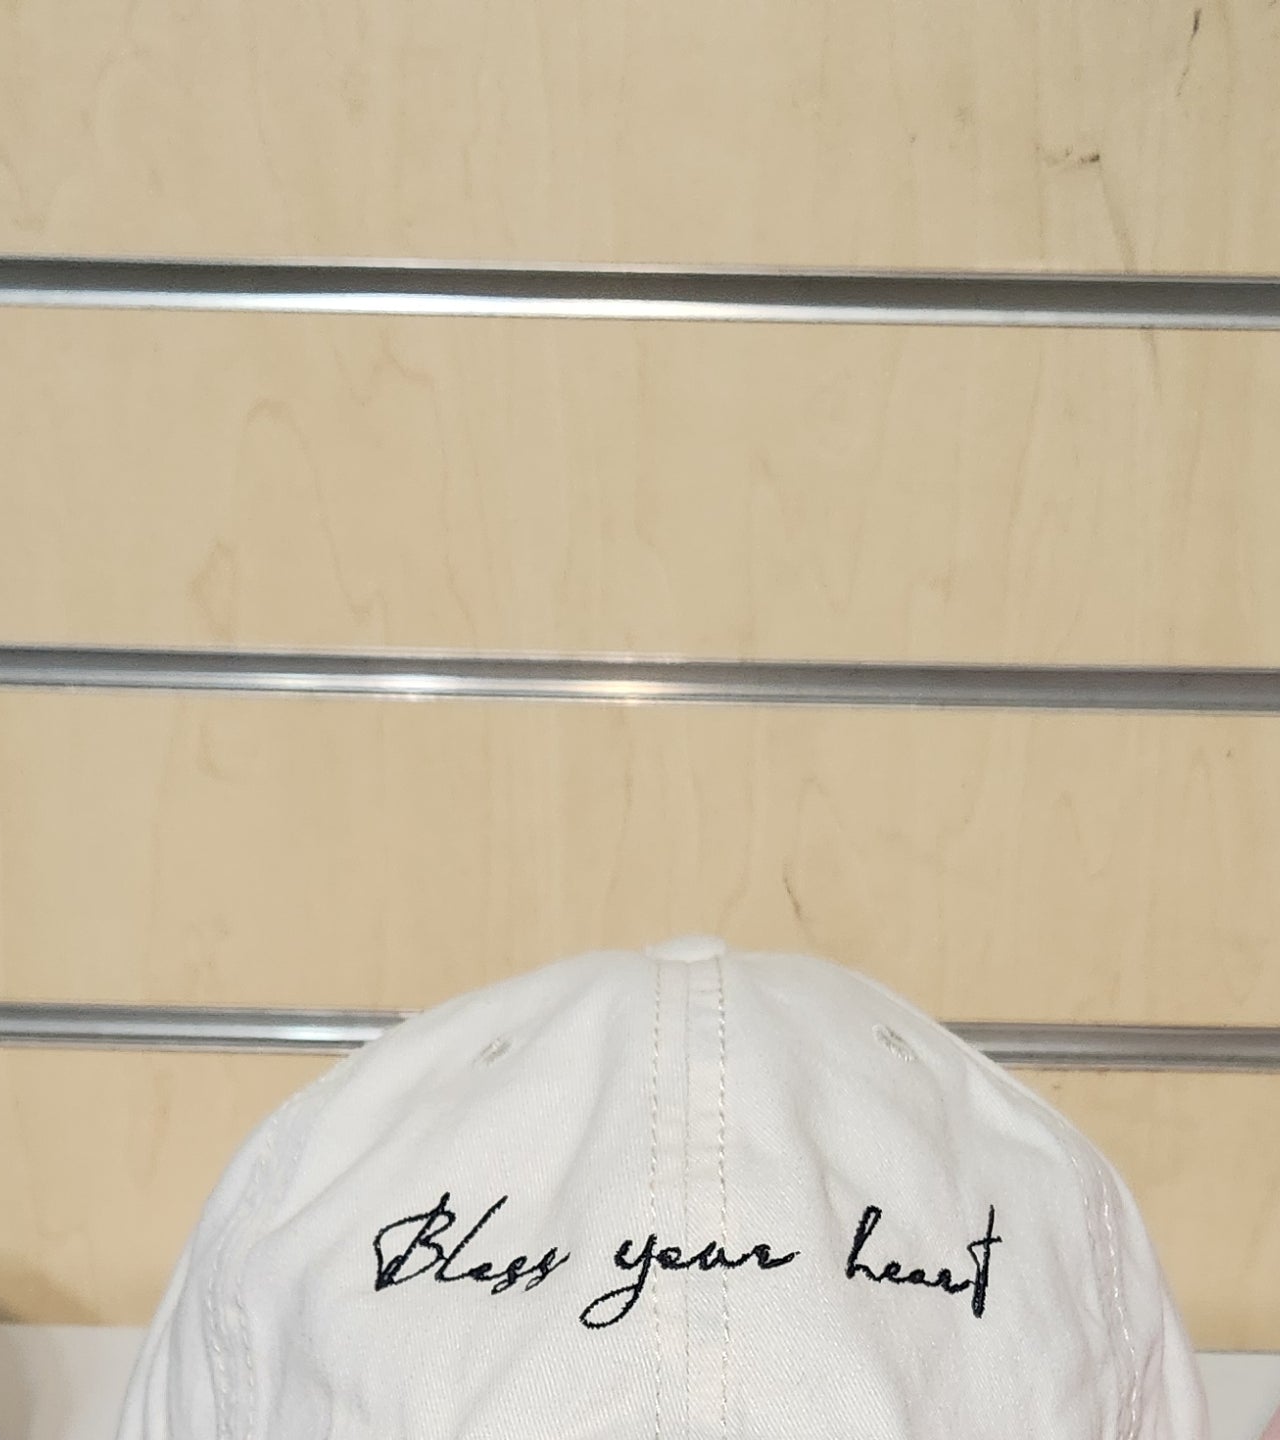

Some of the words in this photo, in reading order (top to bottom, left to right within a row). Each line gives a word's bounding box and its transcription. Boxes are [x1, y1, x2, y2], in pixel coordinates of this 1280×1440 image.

[373, 1192, 570, 1294] Bless
[579, 1234, 801, 1329] your
[845, 1204, 1002, 1319] heart
